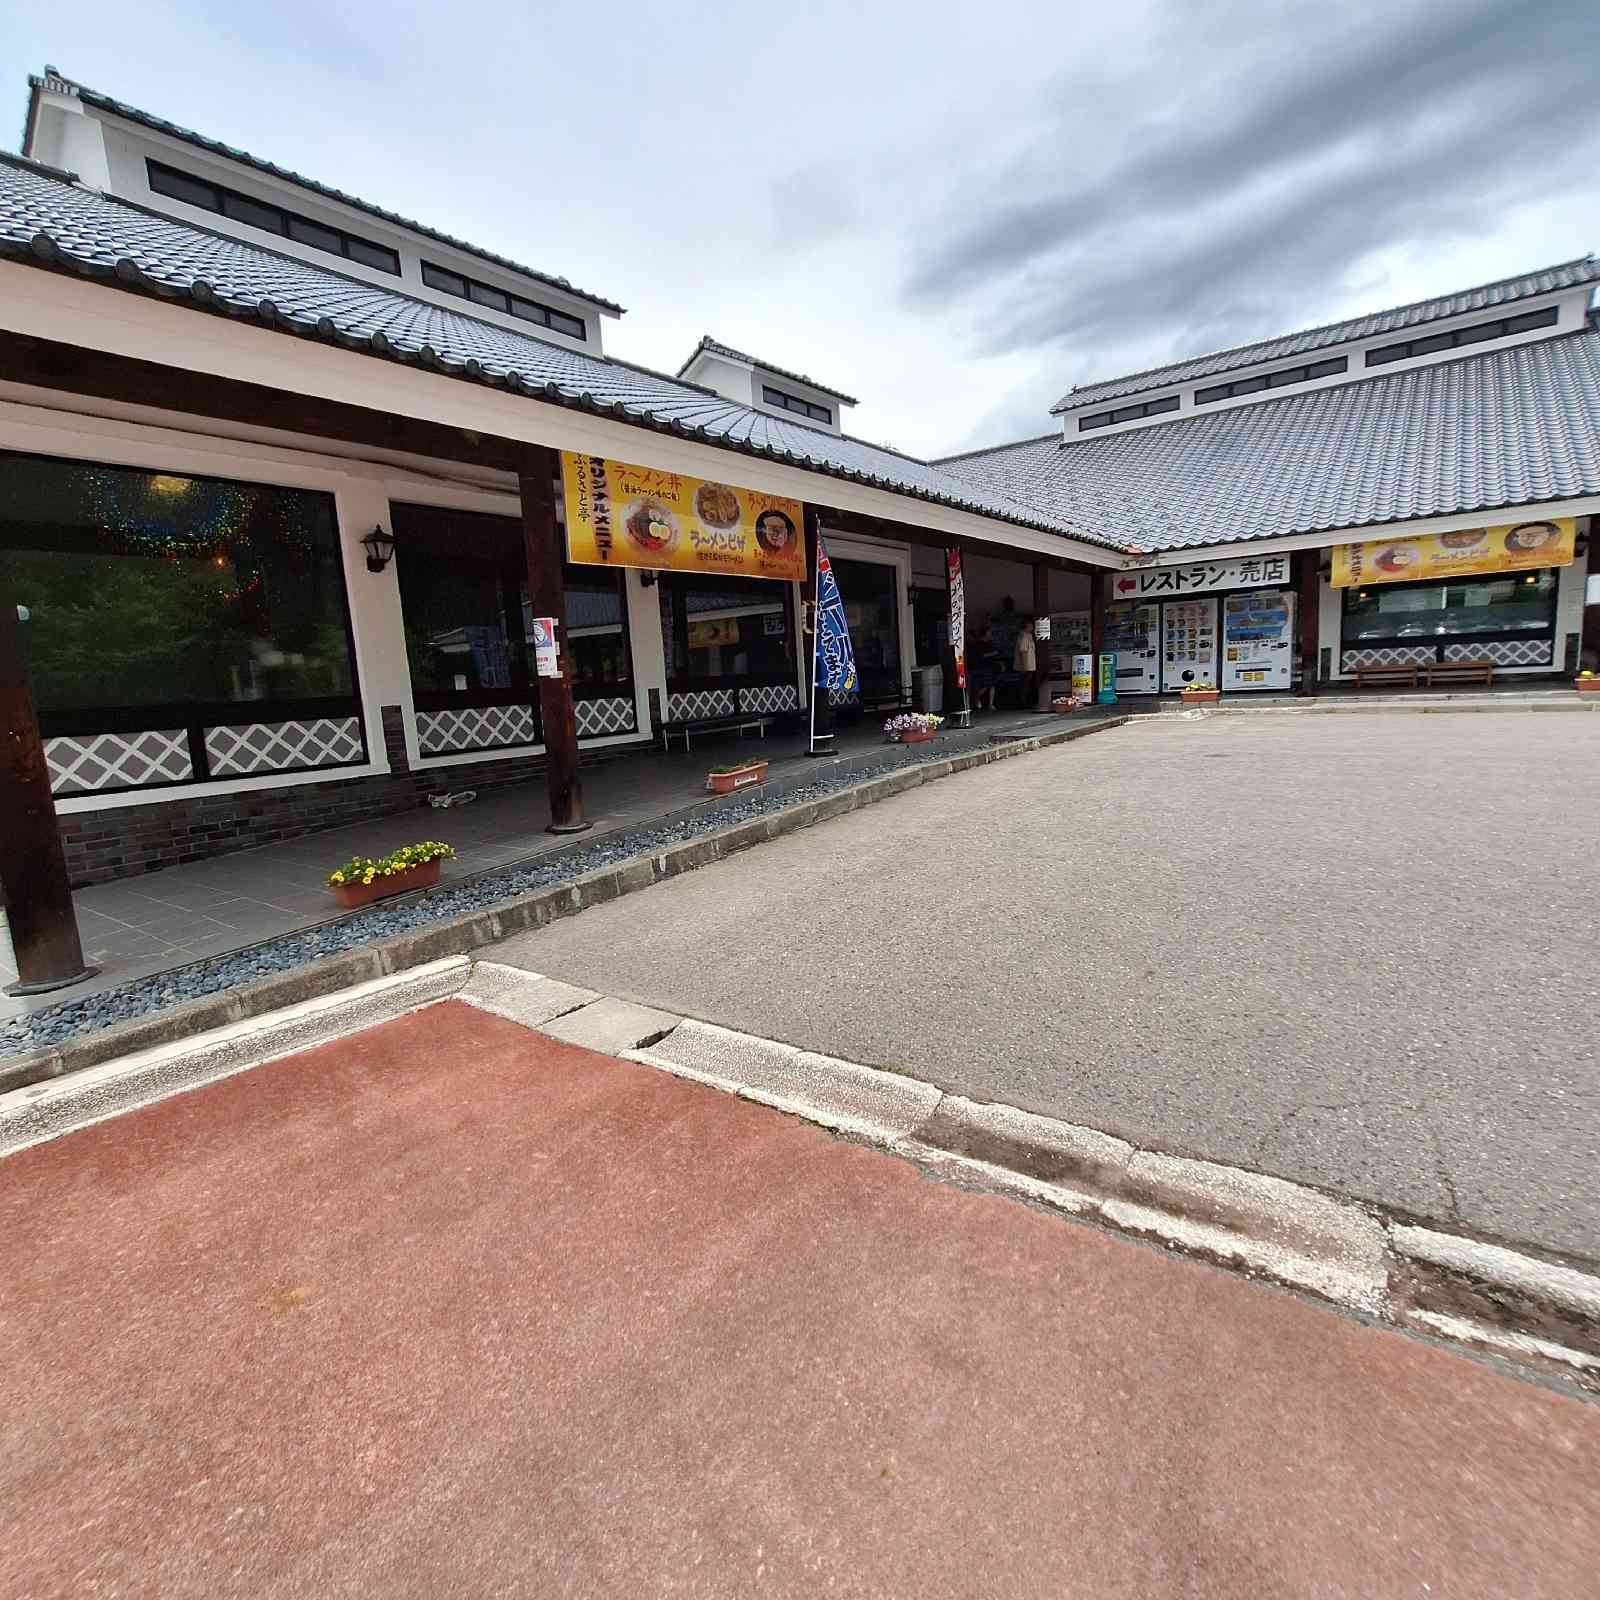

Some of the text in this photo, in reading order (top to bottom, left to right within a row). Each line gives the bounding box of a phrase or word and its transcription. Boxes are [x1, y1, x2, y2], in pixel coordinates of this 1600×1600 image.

[1141, 558, 1285, 592] レストラン・売店
